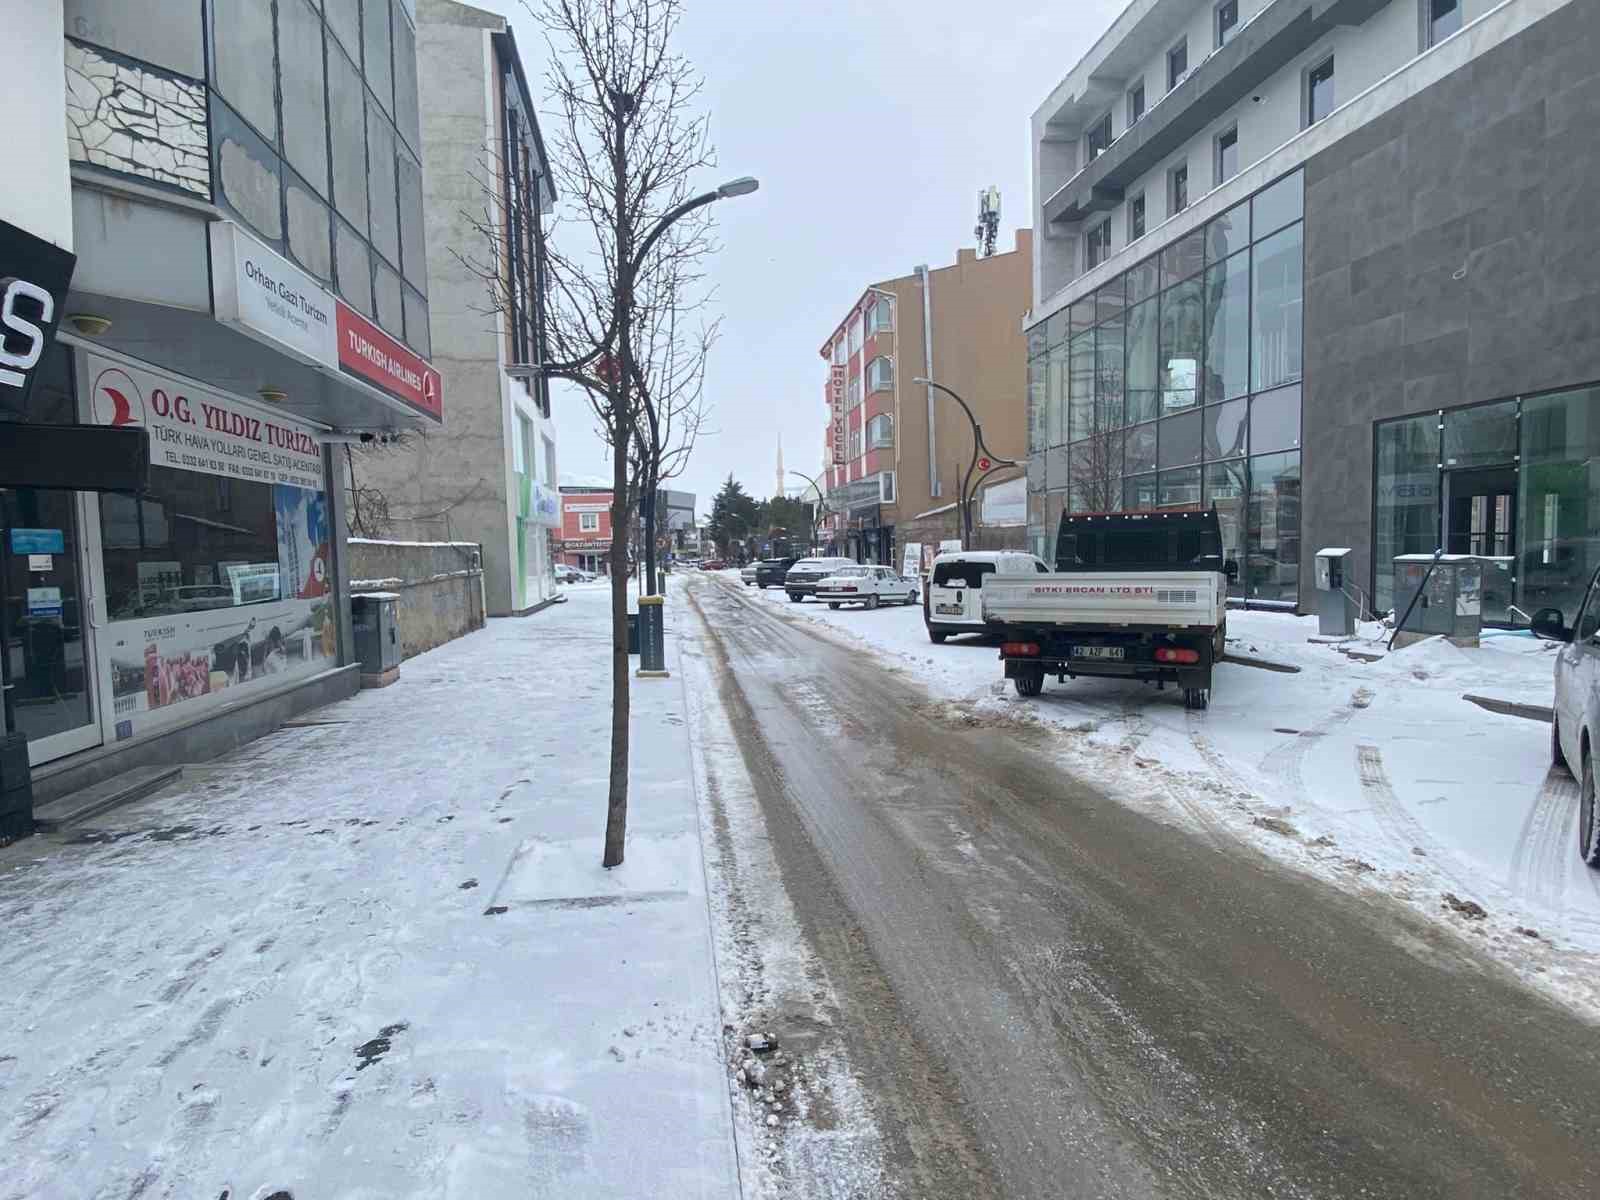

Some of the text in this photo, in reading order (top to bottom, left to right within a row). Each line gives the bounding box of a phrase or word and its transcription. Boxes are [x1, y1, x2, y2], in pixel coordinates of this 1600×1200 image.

[245, 260, 328, 326] Orhan Gazi Turizm
[348, 329, 422, 392] TURKISH AIRLINES
[832, 370, 843, 413] HOTEL
[151, 388, 320, 457] O.G. YILDIZ TURİZM
[152, 424, 182, 445] TÜRK
[184, 432, 210, 450] HAVA
[210, 438, 246, 459] YOLLARI
[247, 447, 273, 465] GENEL
